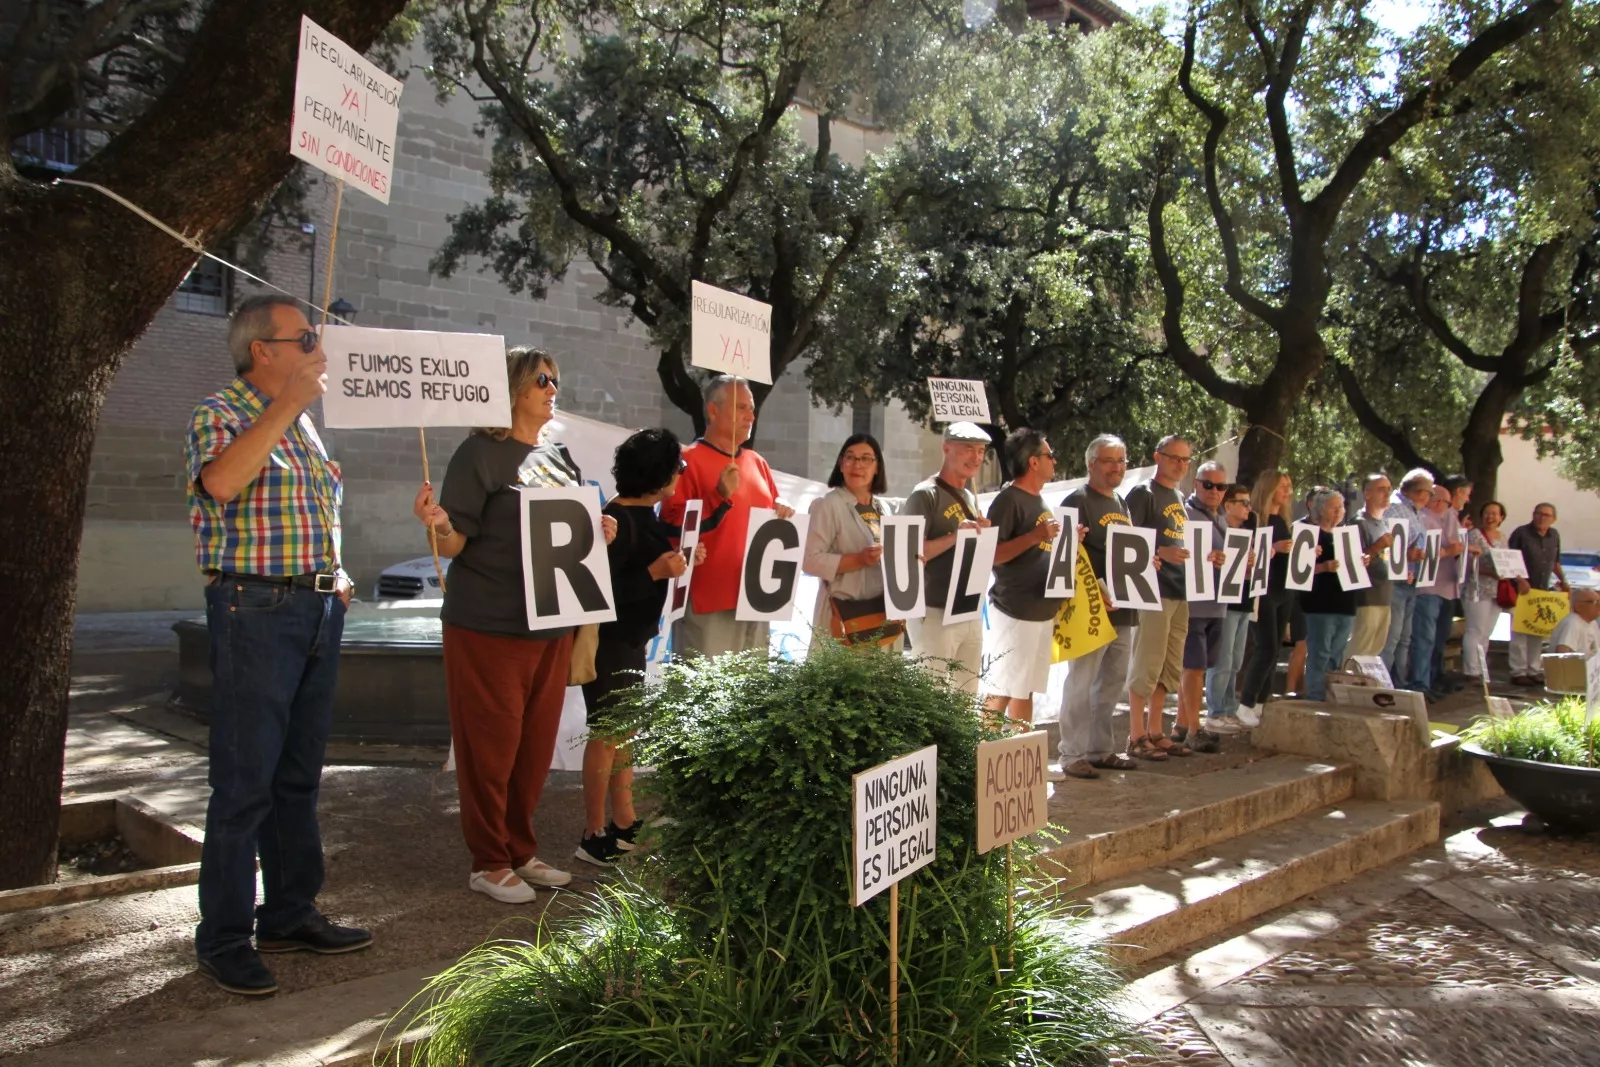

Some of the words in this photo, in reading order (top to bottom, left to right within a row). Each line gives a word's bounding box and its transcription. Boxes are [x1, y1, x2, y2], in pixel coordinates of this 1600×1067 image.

[340, 83, 369, 122] YA!
[303, 96, 391, 163] PERMANENTE
[299, 131, 320, 157] SIN
[325, 144, 388, 194] CONDICIONES
[348, 353, 413, 374] FUIMOS
[420, 357, 470, 378] EXILIO
[720, 334, 751, 370] YA!
[342, 378, 412, 399] SEAMOS
[421, 382, 490, 403] REFUGIO
[931, 380, 976, 392] NINGUNA
[933, 391, 980, 404] PERSONA
[935, 404, 948, 415] ES
[951, 405, 985, 417] ILEGAL
[865, 760, 928, 813] NINGUNA
[985, 744, 1043, 798] ACOGIDA
[865, 794, 930, 850] PERSONA
[993, 789, 1036, 839] DIGNA
[862, 854, 882, 891] ES
[887, 828, 934, 877] ILEGAL
